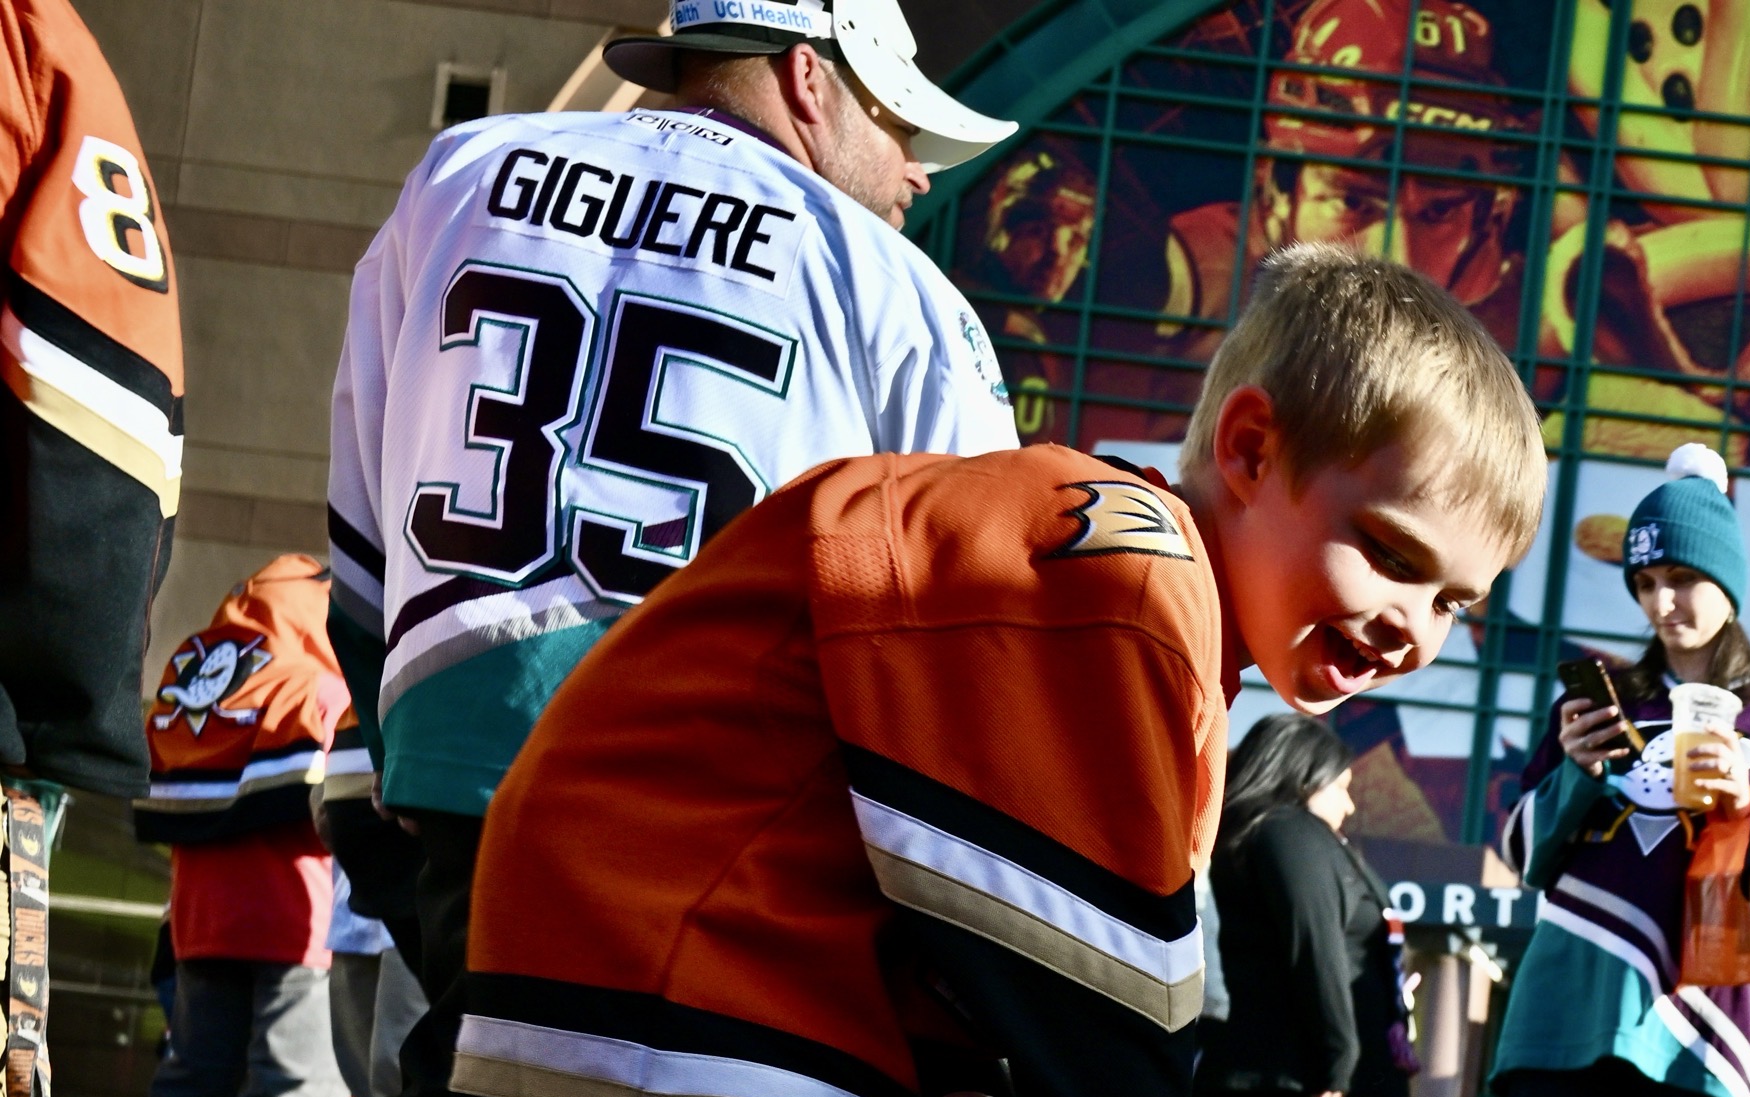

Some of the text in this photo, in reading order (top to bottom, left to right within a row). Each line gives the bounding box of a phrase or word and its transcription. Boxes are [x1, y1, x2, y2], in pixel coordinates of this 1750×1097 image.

[713, 0, 745, 18] UCI
[752, 4, 812, 29] Health
[1415, 10, 1466, 54] 61
[71, 134, 169, 294] 8
[487, 148, 797, 283] GIGUERE
[403, 258, 799, 608] 35
[1388, 881, 1546, 929] ORT
